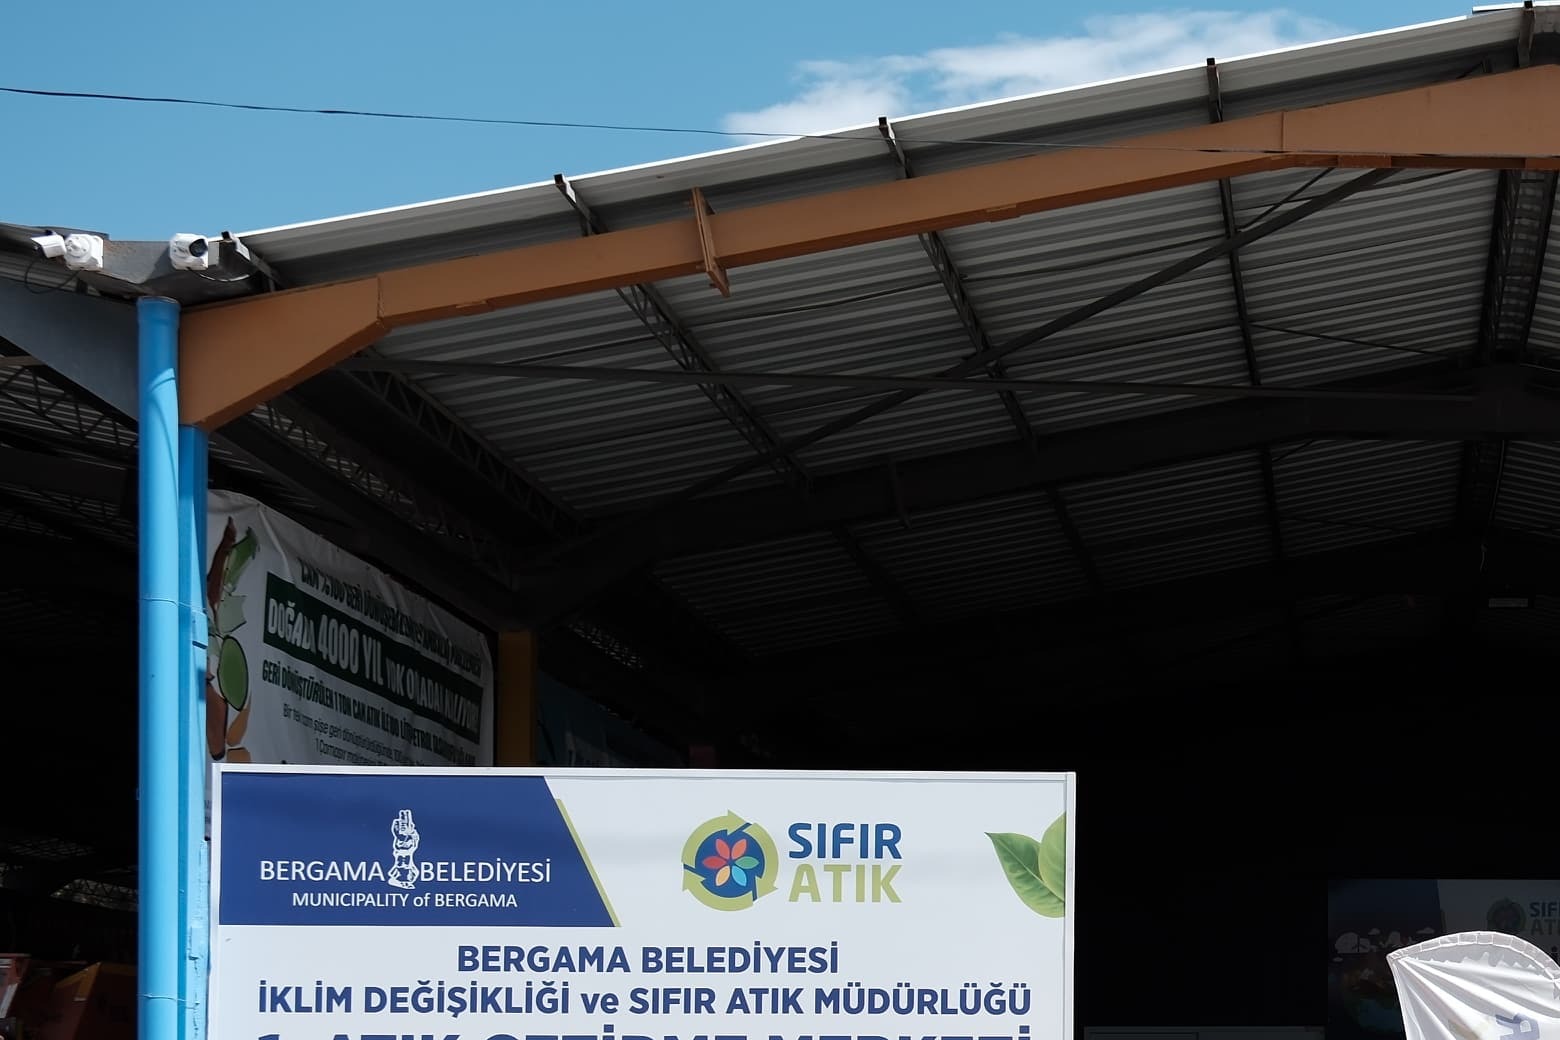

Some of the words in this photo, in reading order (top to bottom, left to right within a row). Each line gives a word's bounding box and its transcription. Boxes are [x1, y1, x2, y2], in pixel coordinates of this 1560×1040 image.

[317, 613, 361, 676] 4000
[361, 633, 385, 687] YIL
[263, 658, 281, 688] GERİ
[281, 666, 335, 710] DÖNÜŞTÜRÜLEN
[352, 699, 368, 725] CAM
[367, 704, 381, 728] ATIK
[787, 822, 903, 860] SIFIR
[260, 860, 385, 882] BERGAMA
[420, 857, 551, 883] BELEDİYESİ
[788, 863, 903, 903] ATIK
[292, 892, 409, 908] MUNICIPALITY
[413, 892, 429, 907] of
[435, 893, 518, 909] BERGAMA
[458, 945, 631, 973] BERGAMA
[641, 940, 839, 974] BELEDİYESİ
[259, 980, 352, 1014] İKLİM
[364, 980, 569, 1018] DEĞİŞİKLİĞİ
[580, 992, 619, 1015] ve
[629, 987, 716, 1015] SIFIR
[726, 987, 804, 1015] ATIK
[814, 981, 1031, 1016] MÜDÜRLÜĞÜ
